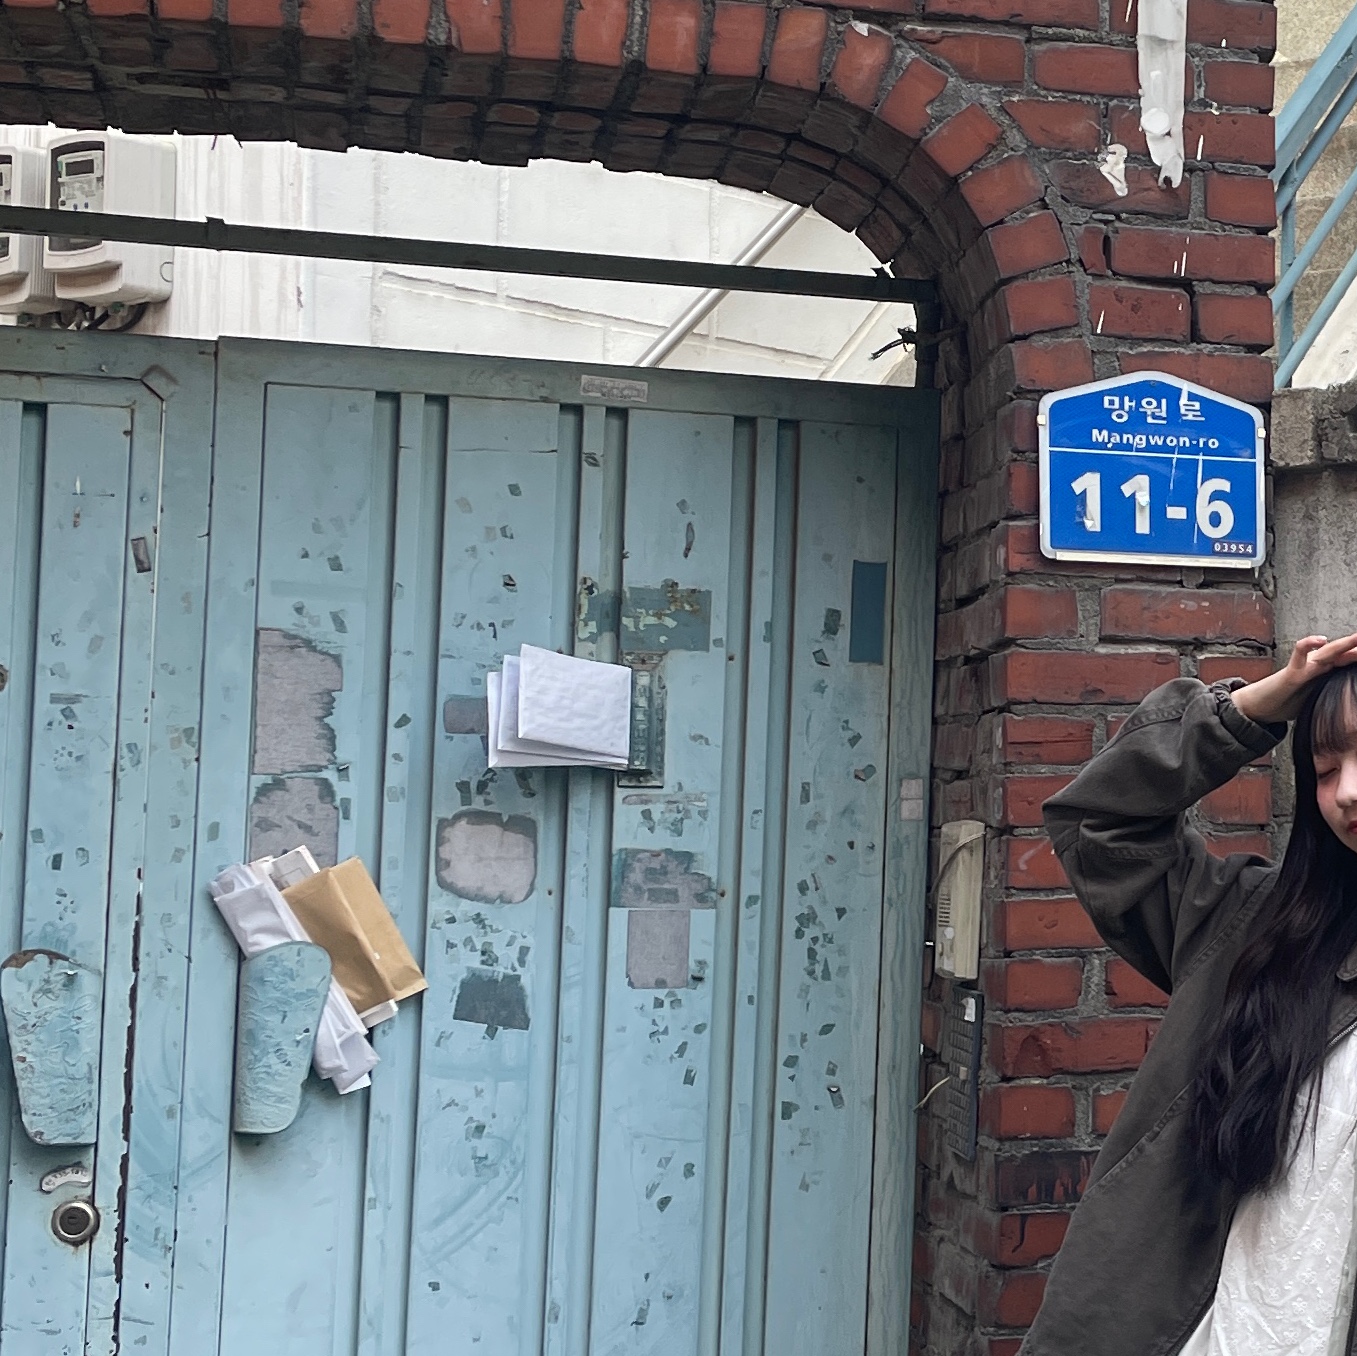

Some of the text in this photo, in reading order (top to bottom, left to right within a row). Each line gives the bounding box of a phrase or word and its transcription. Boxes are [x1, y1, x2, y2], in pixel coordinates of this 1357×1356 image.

[1103, 395, 1206, 425] 망원로
[1091, 428, 1220, 449] Mangwon-ro
[1070, 471, 1235, 539] 11-6
[1214, 542, 1253, 554] 03954
